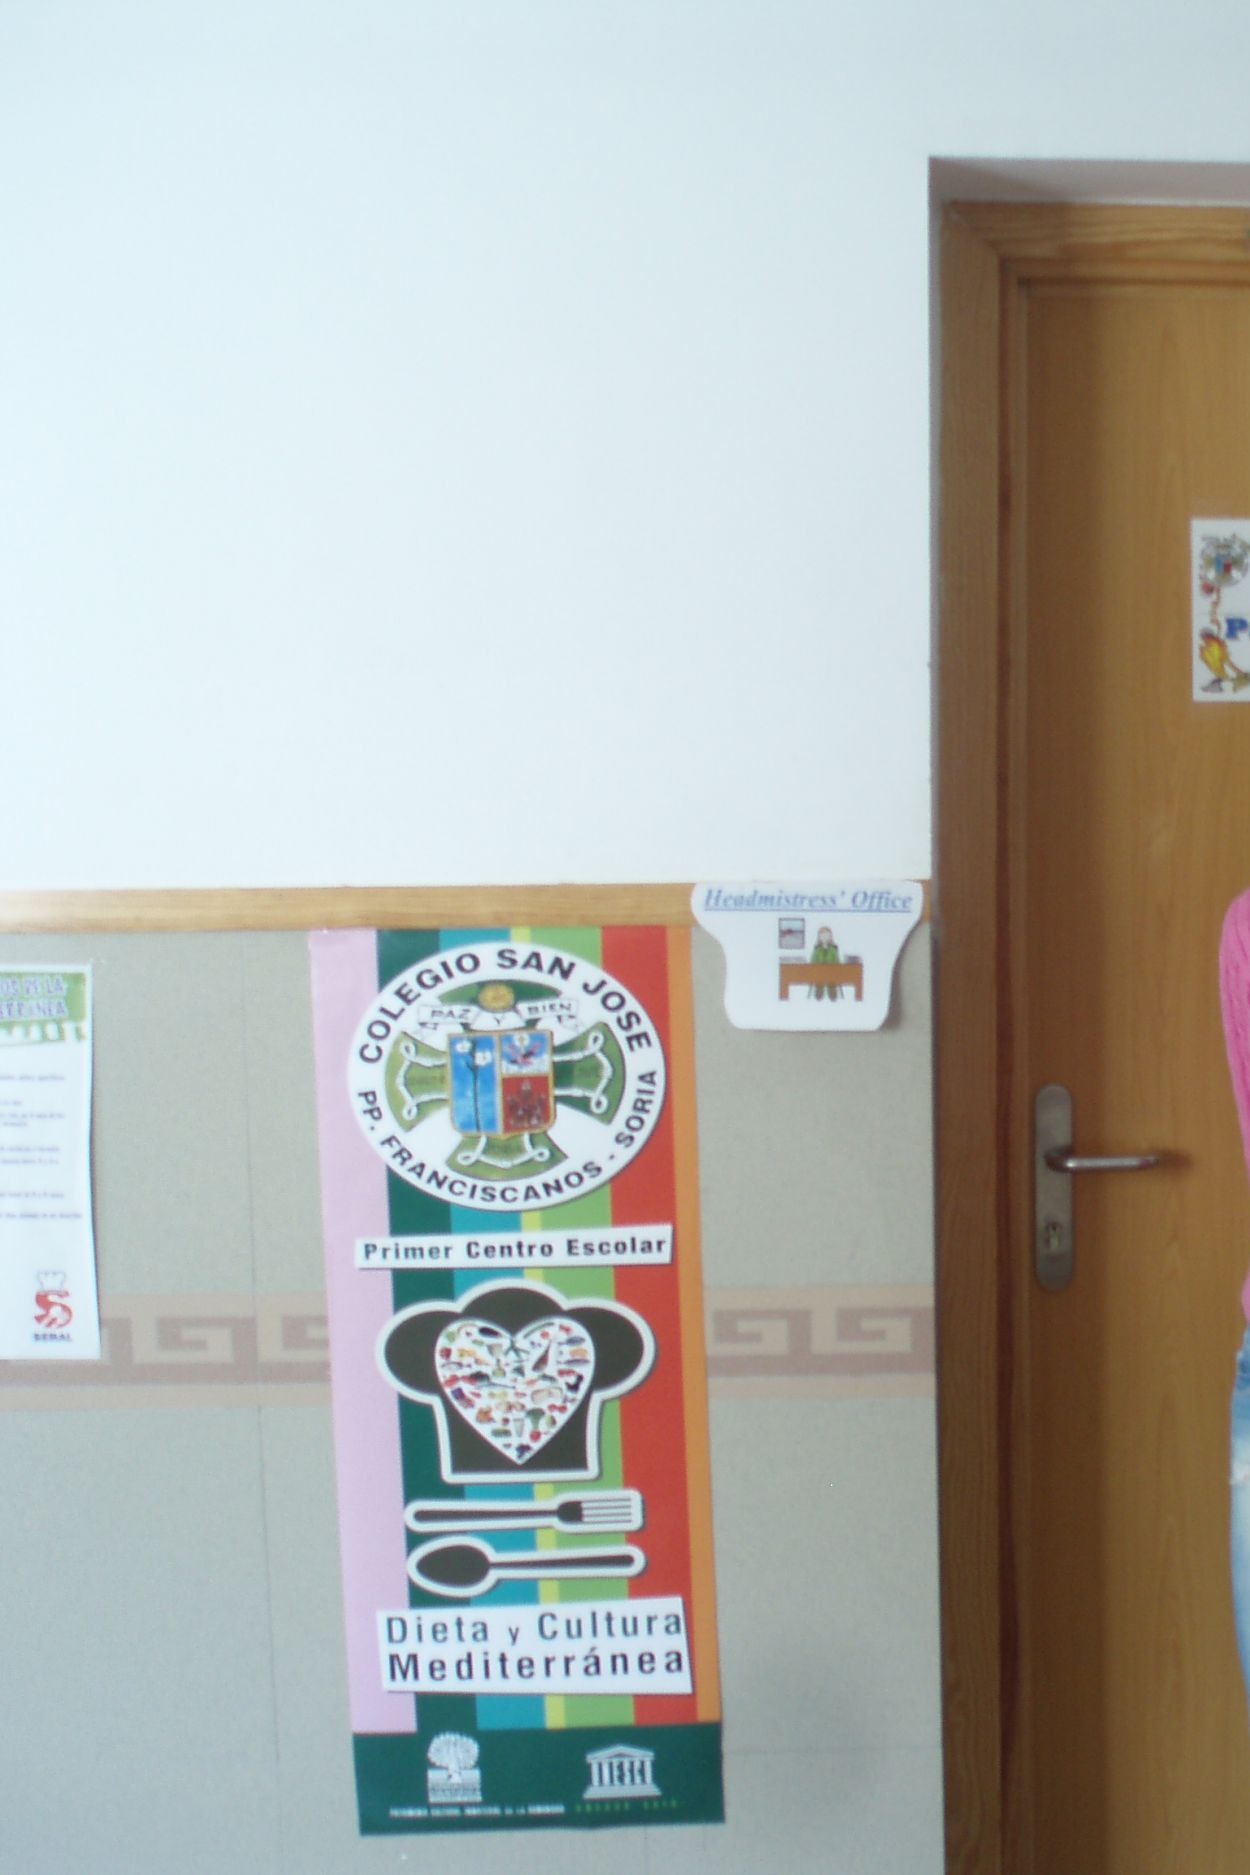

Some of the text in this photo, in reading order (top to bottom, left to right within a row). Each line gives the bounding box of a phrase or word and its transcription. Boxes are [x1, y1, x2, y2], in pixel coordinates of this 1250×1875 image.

[704, 887, 913, 911] Headmistress' Office
[358, 947, 653, 1064] COLEGIO SAN JOSE
[430, 1008, 471, 1021] PAZ
[527, 1001, 573, 1016] BIEN
[357, 1088, 385, 1132] PP.
[379, 1132, 603, 1204] FRANCISCANOS
[614, 1069, 658, 1150] SORIA
[363, 1237, 667, 1261] Primer Centro Escolar
[386, 1610, 682, 1646] Dieta y Cultura
[388, 1647, 684, 1682] Mediterránea
